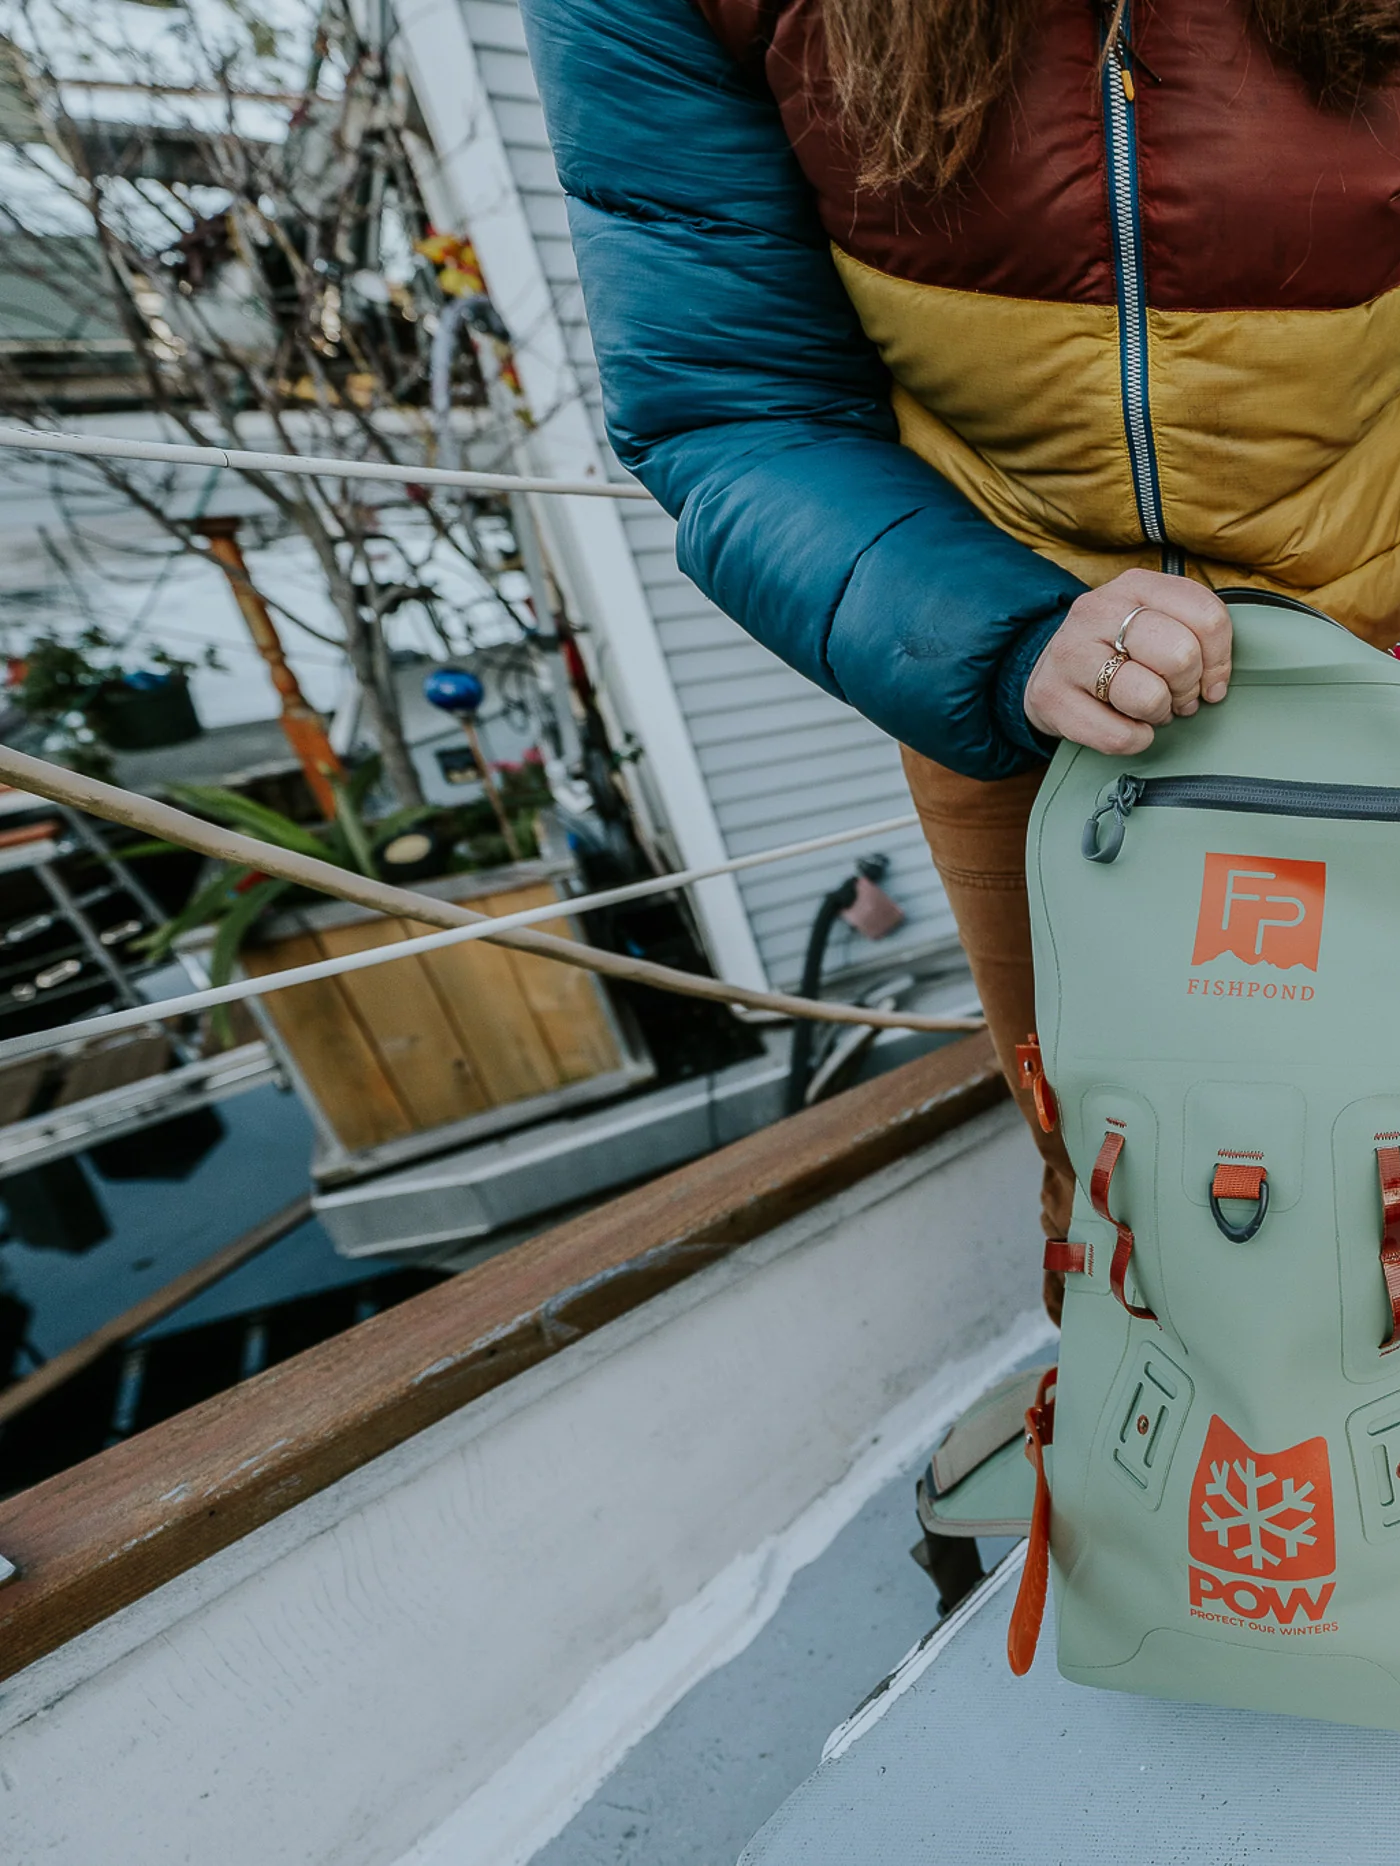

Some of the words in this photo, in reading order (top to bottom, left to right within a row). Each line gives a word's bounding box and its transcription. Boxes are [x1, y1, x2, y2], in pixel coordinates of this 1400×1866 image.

[1186, 978, 1315, 1001] FISHPOND
[1188, 1564, 1337, 1625] POW
[1189, 1608, 1245, 1628] PROTECT
[1248, 1621, 1275, 1635] OUR
[1279, 1621, 1339, 1636] WINTERS
